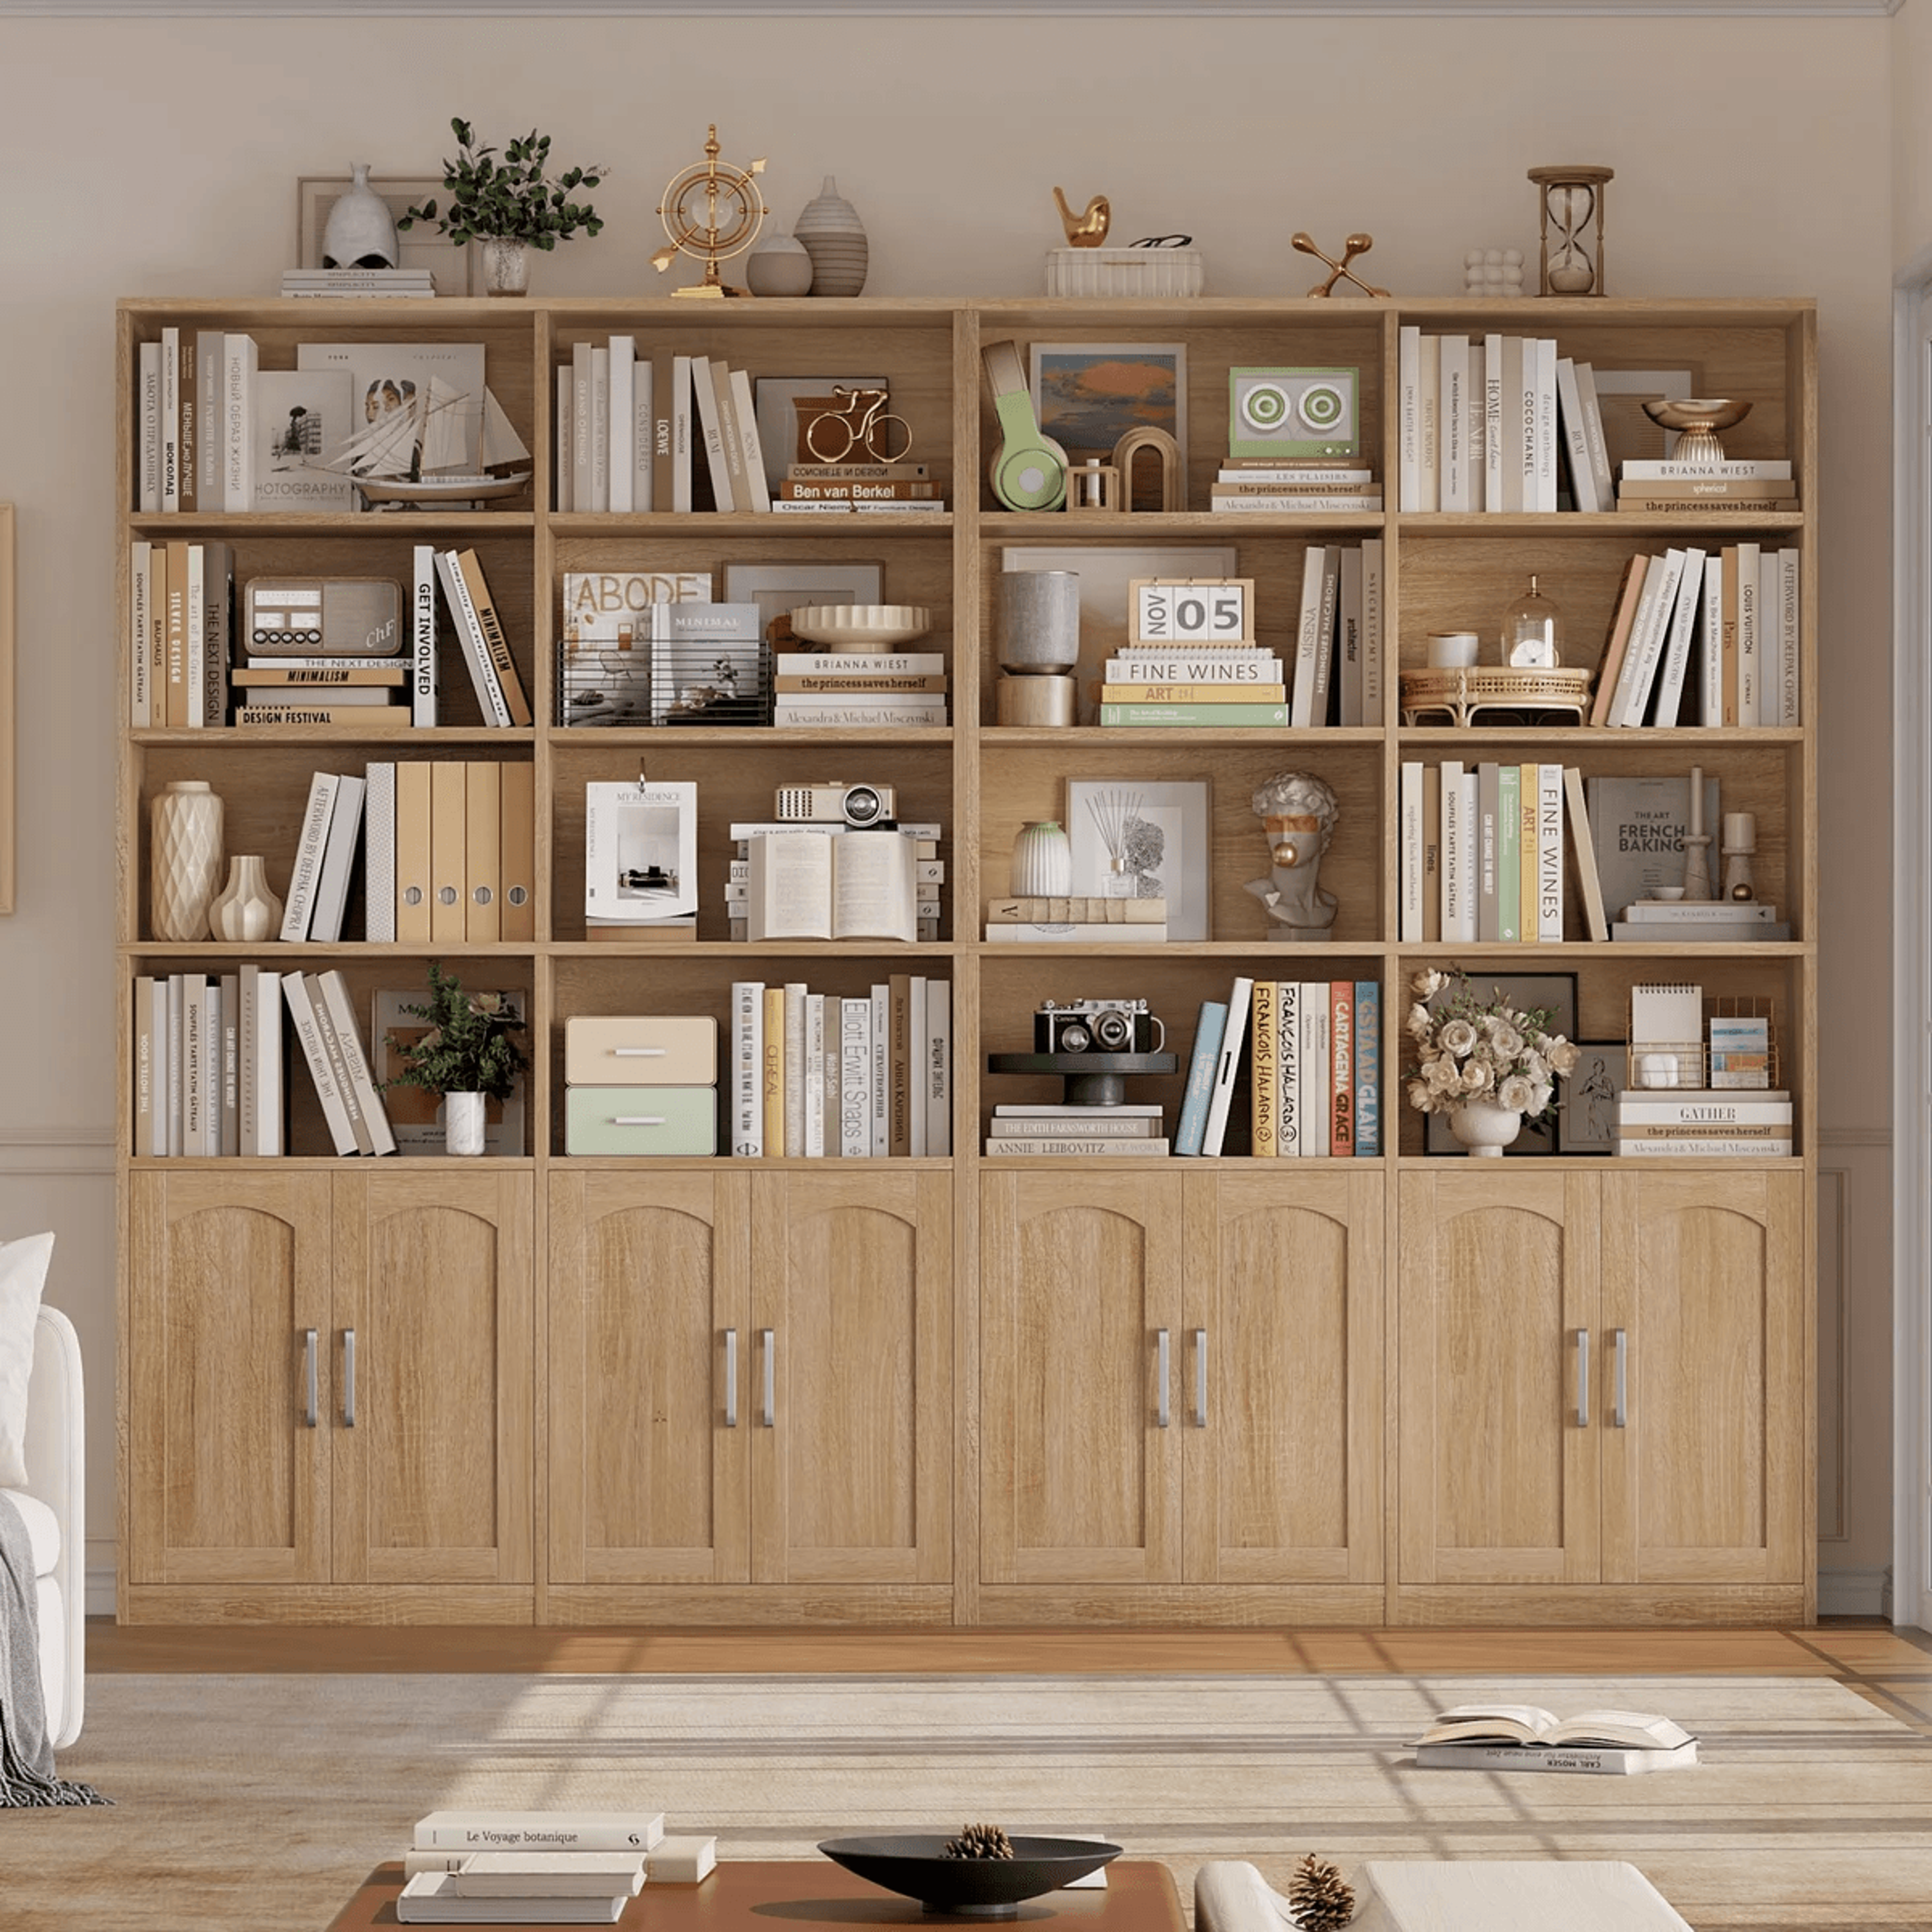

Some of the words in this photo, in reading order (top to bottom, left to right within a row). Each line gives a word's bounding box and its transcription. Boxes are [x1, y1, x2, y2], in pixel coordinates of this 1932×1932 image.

[231, 357, 242, 400] НОВЫЙ
[578, 380, 587, 416] GRAND
[1487, 379, 1500, 423] HOME
[1541, 394, 1552, 427] design
[231, 404, 241, 442] ОБРАЗ
[639, 404, 649, 471] CONSIDERED
[657, 419, 669, 455] LOEWE
[578, 419, 587, 465] OPENING
[1524, 427, 1534, 476] CHANEL
[166, 442, 175, 496] ШОКОЛАД
[231, 447, 241, 491] ЖИЗНИ
[1660, 466, 1715, 475] BRIANNA
[1719, 466, 1755, 475] WIEST
[254, 482, 346, 495] HOTOGRAPHY
[793, 485, 820, 498] Ben
[824, 487, 848, 498] van
[852, 485, 895, 498] Berkel
[1239, 485, 1256, 493] the
[1645, 502, 1664, 511] the
[1739, 501, 1778, 511] herself
[418, 583, 430, 613] GET
[576, 575, 699, 612] ABODE
[1744, 584, 1752, 613] LOUIS
[1784, 561, 1795, 623] AFTERWORD
[190, 605, 200, 619] art
[207, 602, 219, 627] THE
[675, 617, 741, 626] MINIMAL
[1147, 594, 1166, 634] NOV
[1176, 599, 1239, 630] 05
[479, 607, 511, 672] MINIMALISM
[1724, 620, 1735, 650] Paris
[1744, 615, 1752, 654] VUITTON
[1784, 625, 1795, 638] BY
[207, 631, 219, 666] NEXT
[418, 617, 430, 695] INVOLVED
[1784, 639, 1795, 677] DEEPAK
[287, 671, 349, 682] MINIMALISM
[814, 660, 868, 669] BRIANNA
[873, 660, 909, 669] WIEST
[1130, 664, 1177, 680] FINE
[1187, 664, 1258, 680] WINES
[207, 670, 219, 720] DESIGN
[801, 678, 818, 688] the
[890, 677, 927, 688] herself
[1144, 687, 1174, 700] ART
[1784, 679, 1795, 719] CHOPRA
[243, 712, 282, 724] DESIGN
[285, 712, 332, 724] FESTIVAL
[843, 711, 880, 723] Michael
[617, 792, 631, 801] MY
[632, 792, 679, 801] RESIDENCE
[1523, 805, 1536, 834] ART
[1543, 788, 1558, 837] FINE
[1634, 811, 1650, 819] THE
[1653, 811, 1670, 819] ART
[1448, 831, 1456, 855] TARTE
[1619, 825, 1685, 838] FRENCH
[1619, 838, 1686, 852] BAKING
[1427, 844, 1437, 875] lines.
[1448, 857, 1456, 879] TATIN
[1543, 846, 1558, 919] WINES
[845, 1002, 867, 1040] Elliott
[190, 1044, 198, 1069] TARTE
[1335, 1001, 1349, 1093] CARTAGENA
[1358, 1001, 1377, 1084] GSTAAD
[845, 1045, 867, 1085] Erwitt
[190, 1070, 198, 1094] TATIN
[1280, 1064, 1297, 1124] HALARD
[842, 1090, 867, 1138] Snaps
[1004, 1123, 1021, 1133] THE
[1023, 1123, 1049, 1133] EDITH
[1051, 1123, 1107, 1133] FARNSWORTH
[1109, 1123, 1139, 1133] HOUSE
[1335, 1093, 1349, 1142] GRACE
[1358, 1085, 1377, 1142] GLAM
[1679, 1107, 1736, 1119] GATHER
[1647, 1126, 1665, 1136] the
[995, 1143, 1034, 1154] ANNIE
[1042, 1143, 1105, 1154] LEIBOVITZ
[1546, 1759, 1575, 1768] MOSER
[1578, 1760, 1601, 1768] CARL
[466, 1831, 478, 1842] Le
[482, 1831, 520, 1845] Voyage
[523, 1830, 578, 1845] botanique
